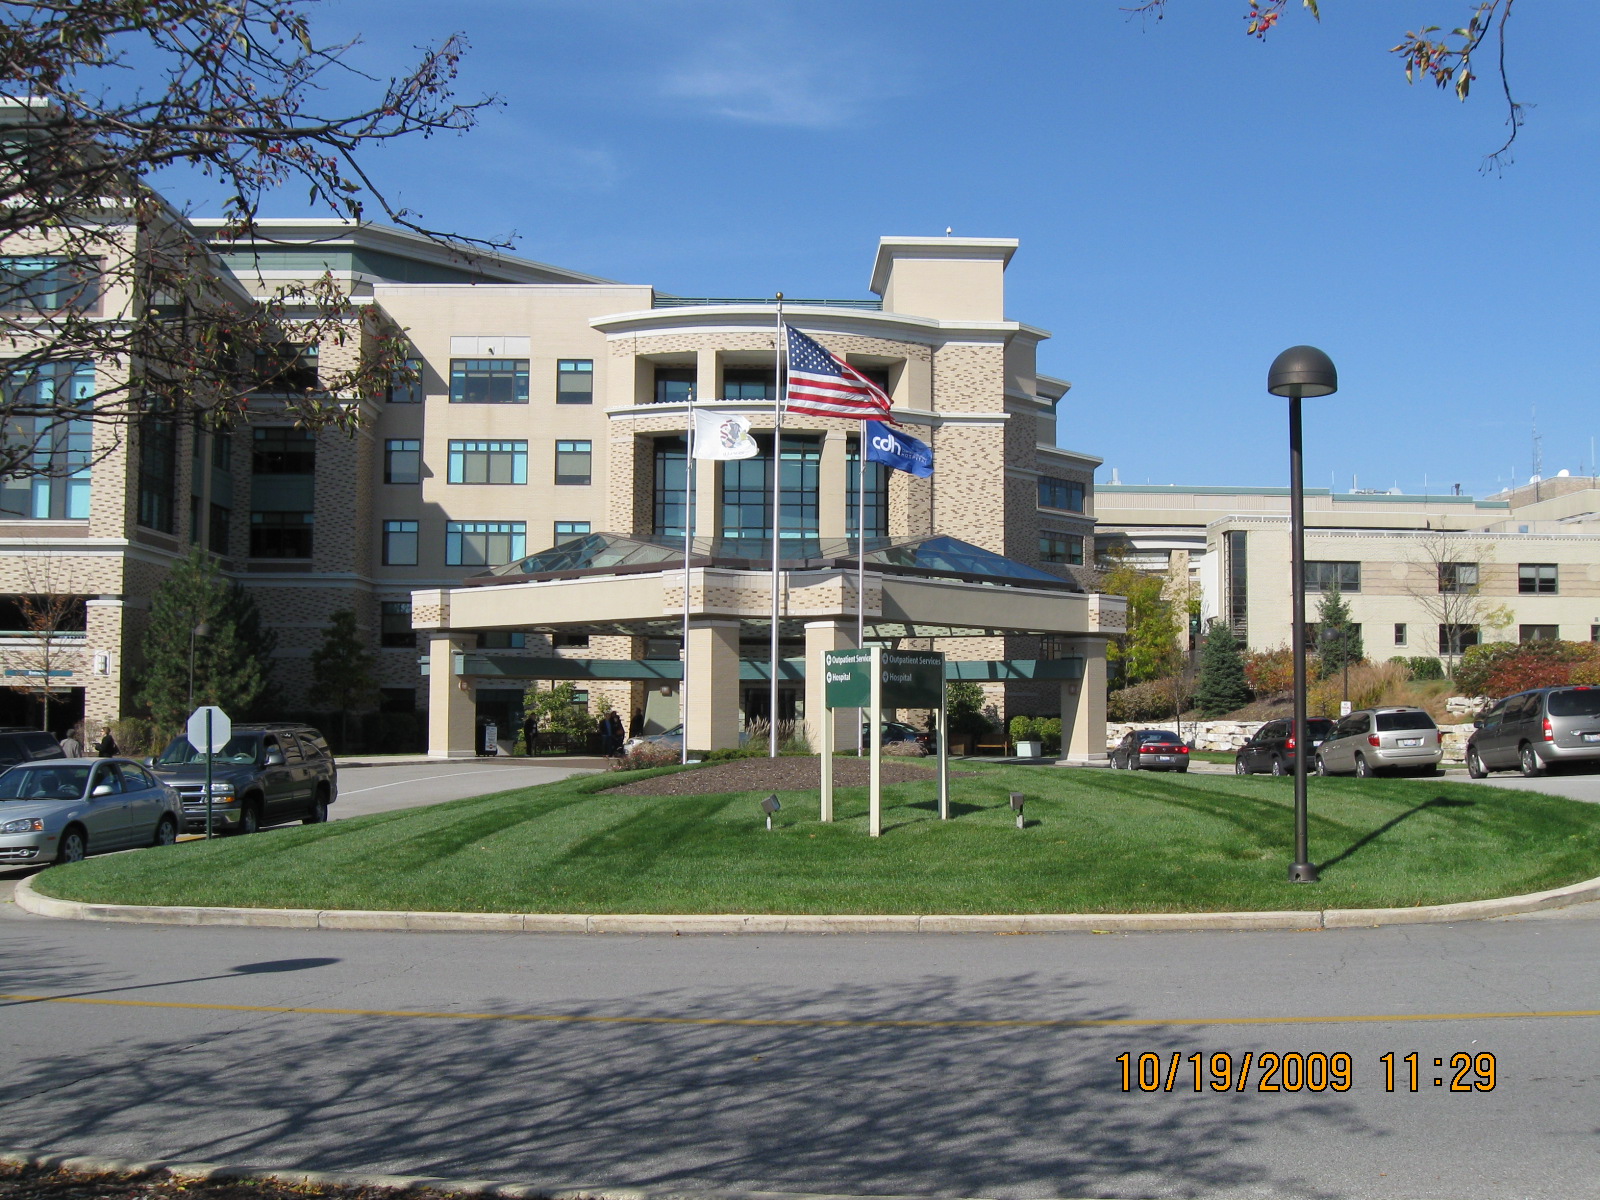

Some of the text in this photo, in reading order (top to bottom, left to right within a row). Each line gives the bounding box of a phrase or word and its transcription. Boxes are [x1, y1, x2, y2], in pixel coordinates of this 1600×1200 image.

[872, 434, 901, 456] cdh
[831, 654, 856, 666] Outpatient
[889, 655, 941, 666] Outpatient Services
[832, 670, 851, 683] Hospital
[889, 672, 912, 684] Hospital
